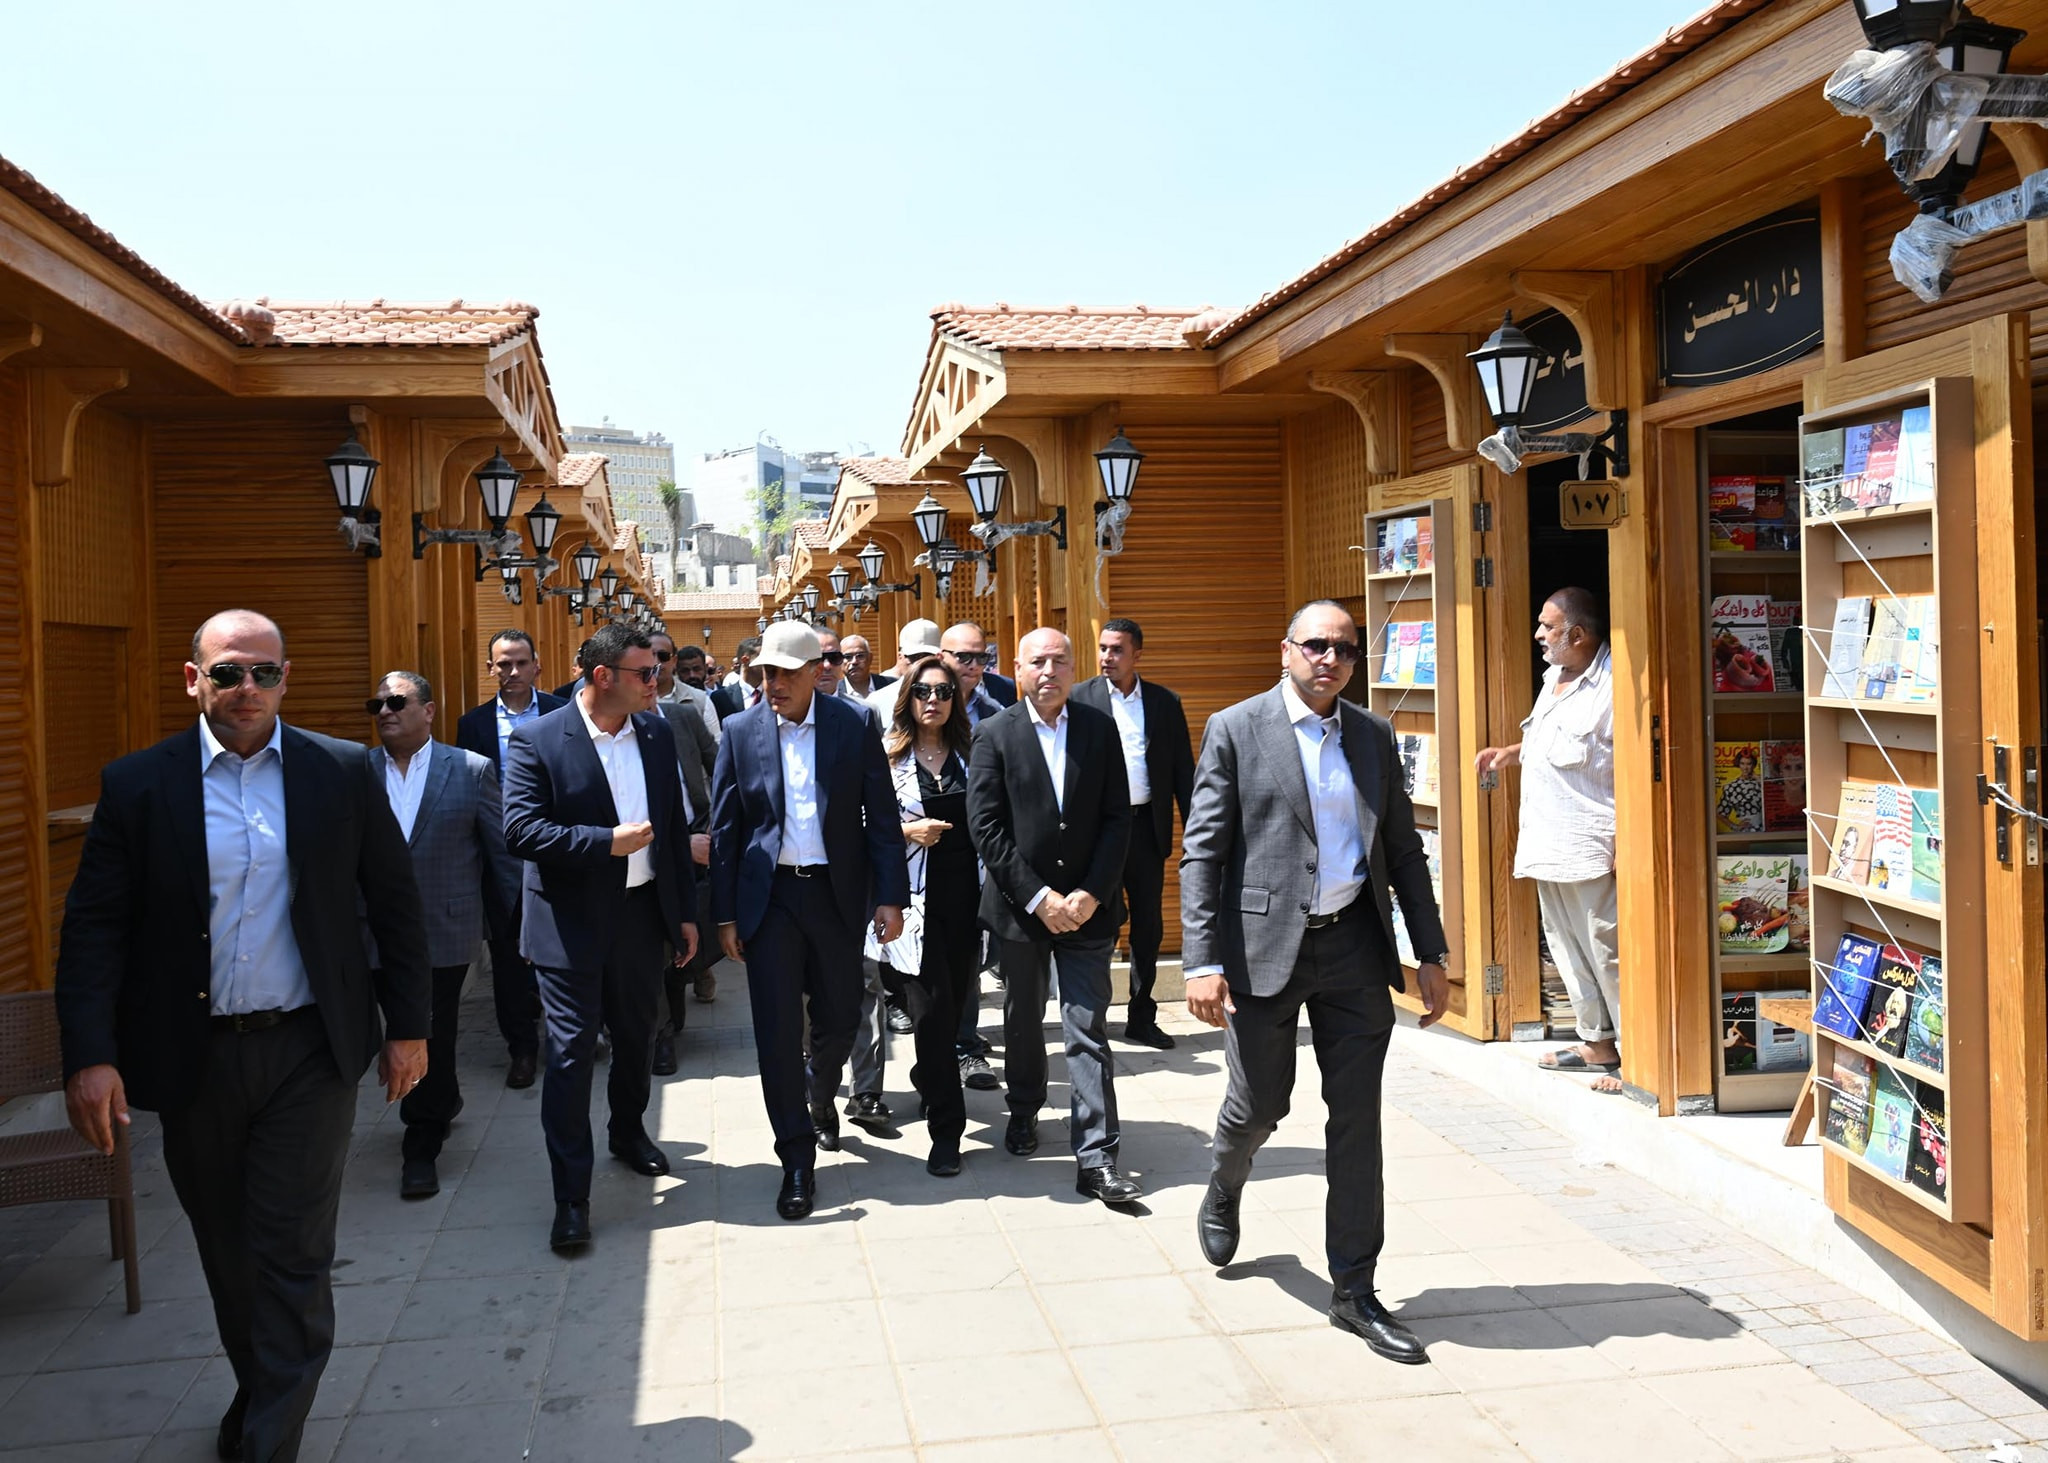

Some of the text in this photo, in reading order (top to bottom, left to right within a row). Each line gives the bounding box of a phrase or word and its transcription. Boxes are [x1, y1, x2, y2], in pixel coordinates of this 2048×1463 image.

[1684, 266, 1800, 343] دار الحسن
[1572, 493, 1610, 516] ١٠٧
[1751, 599, 1769, 618] كل
[1766, 861, 1789, 878] كل
